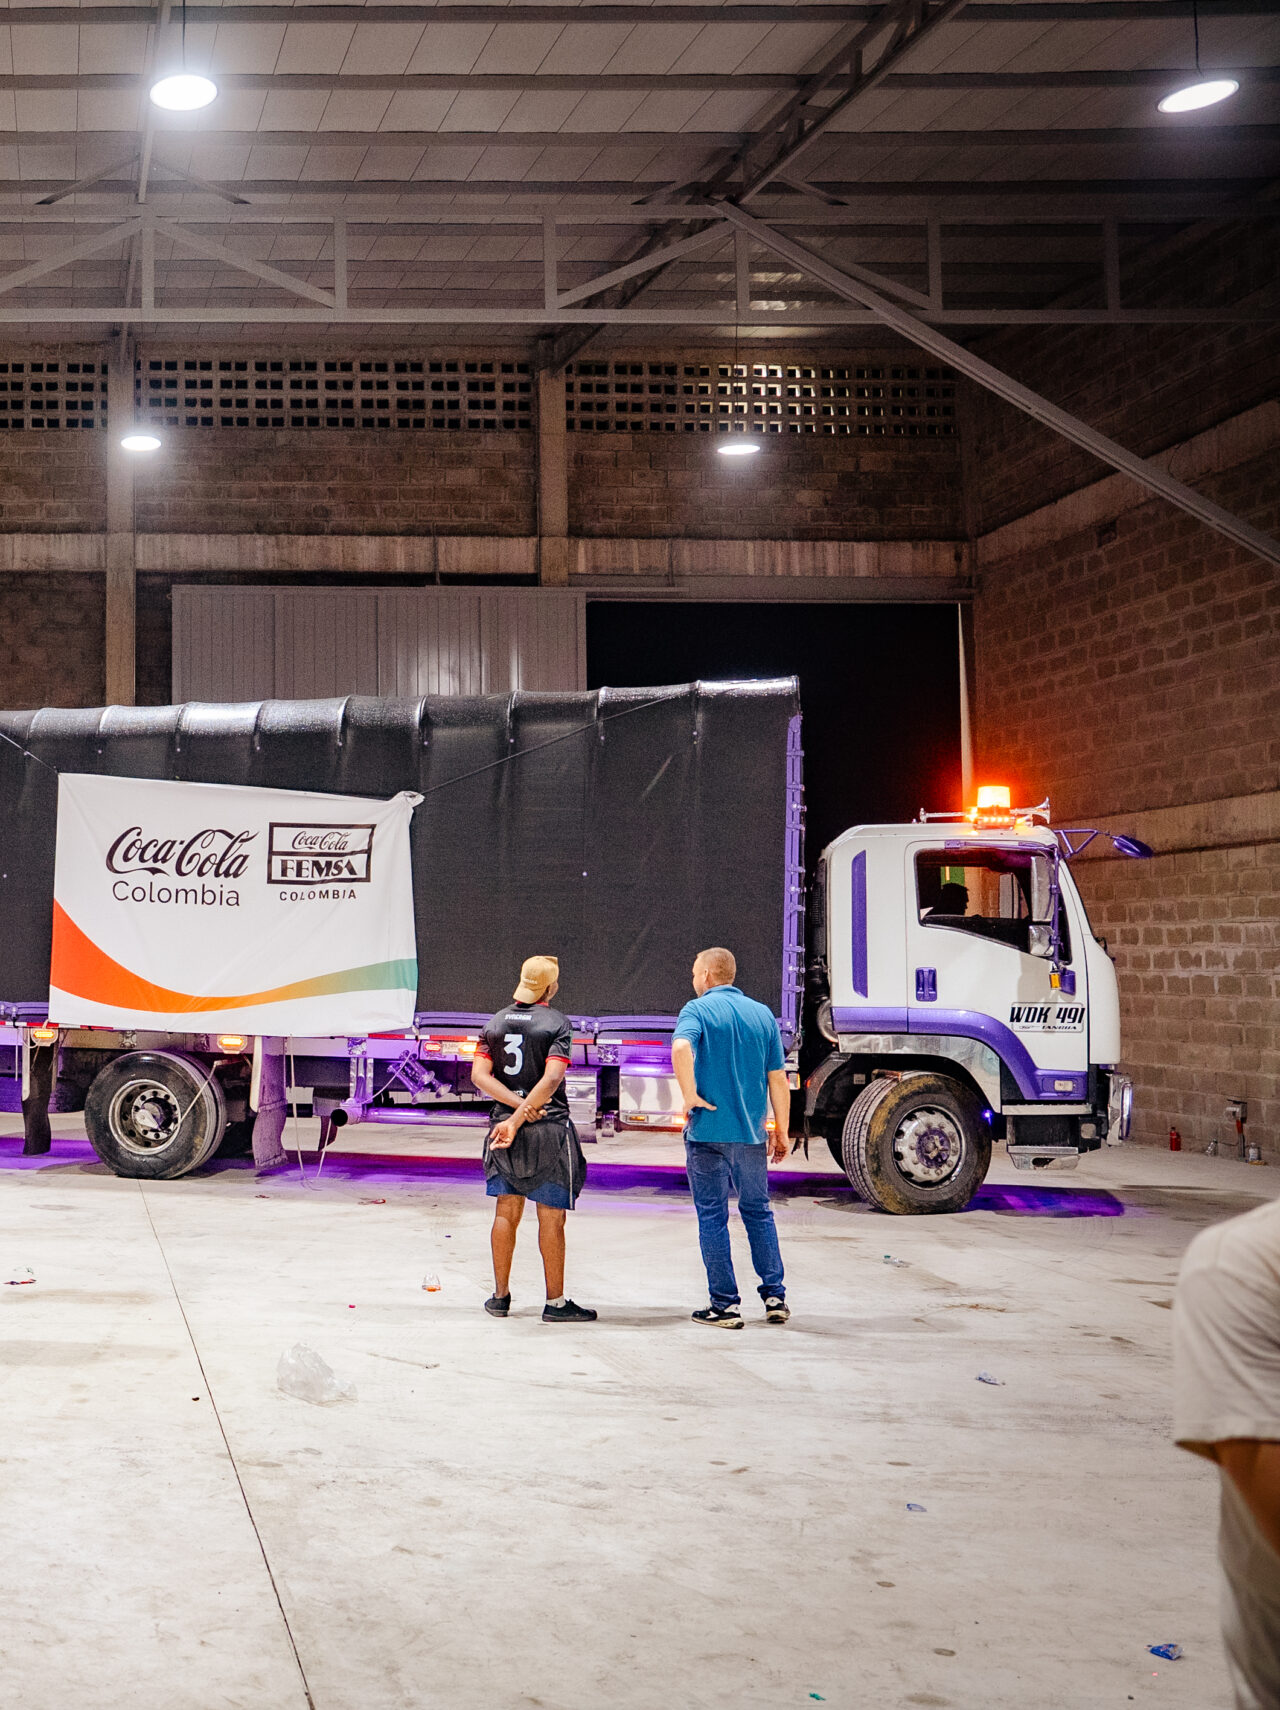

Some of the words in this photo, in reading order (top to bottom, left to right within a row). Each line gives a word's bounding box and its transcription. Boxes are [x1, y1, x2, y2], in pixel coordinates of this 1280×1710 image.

[291, 830, 352, 851] Coca-Cola
[106, 826, 260, 878] Coca-Cola
[280, 859, 357, 878] FEMSA
[112, 880, 240, 906] Colombia
[279, 889, 357, 901] COLOMBIA
[1009, 1006, 1052, 1024] WDK
[1056, 1007, 1086, 1024] 491
[503, 1033, 523, 1076] 3
